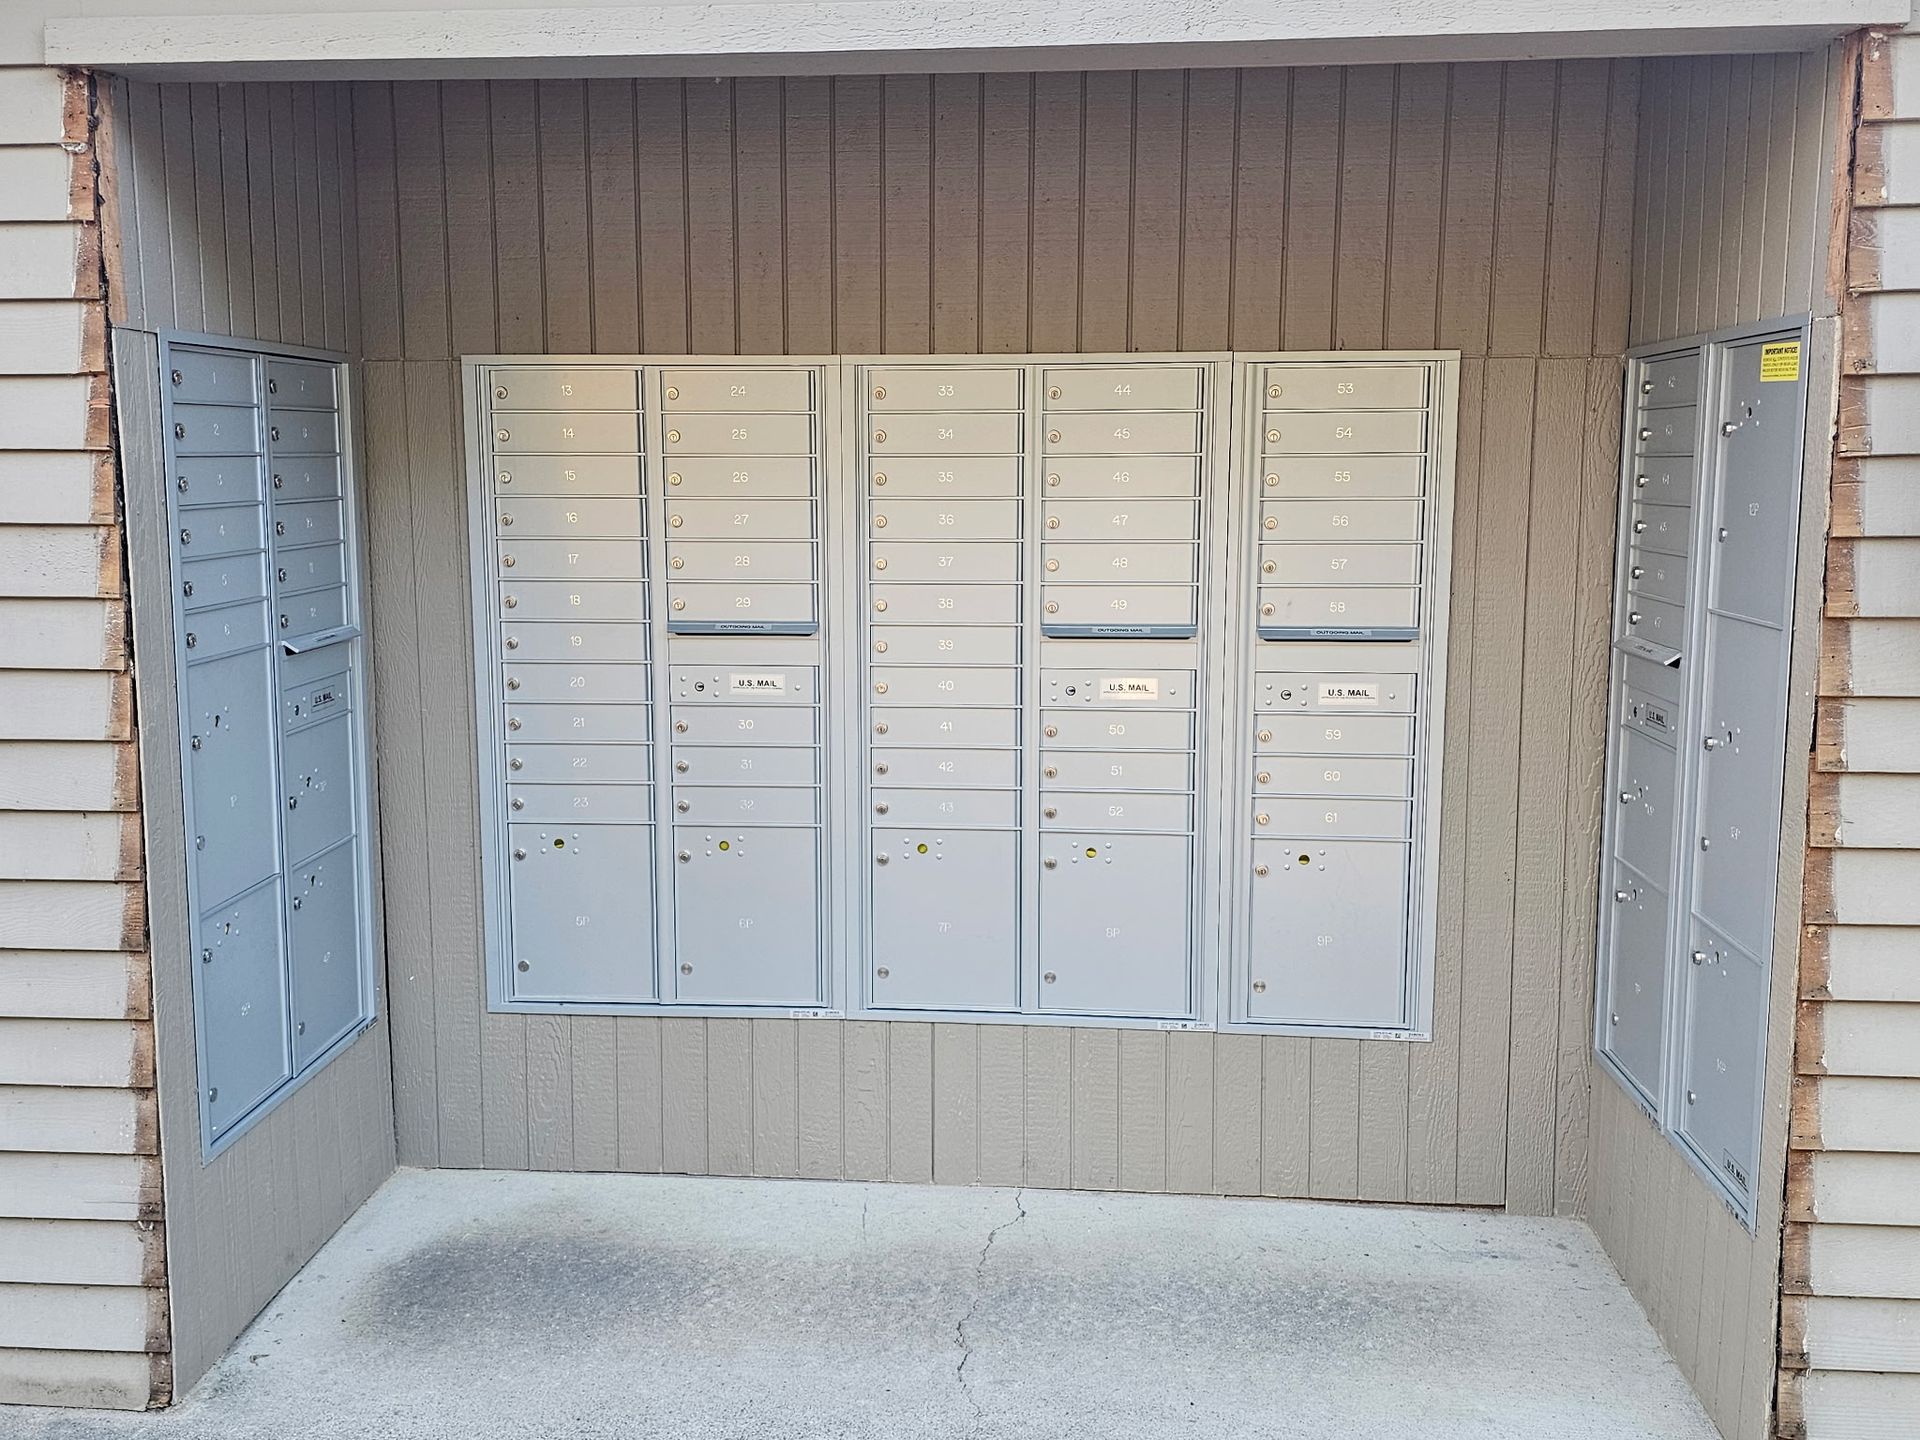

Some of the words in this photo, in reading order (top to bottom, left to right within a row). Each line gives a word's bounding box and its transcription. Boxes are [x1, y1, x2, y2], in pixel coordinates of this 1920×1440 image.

[561, 384, 573, 397] 13
[730, 385, 747, 397] 24
[937, 385, 954, 397] 33
[1113, 384, 1132, 396] 44
[1337, 383, 1354, 395] 53
[213, 424, 220, 436] 2
[562, 427, 575, 439] 14
[731, 428, 748, 440] 25
[937, 428, 954, 440] 34
[1113, 428, 1131, 440] 45
[1335, 427, 1353, 439] 54
[216, 474, 223, 486] 3
[304, 473, 310, 482] 9
[564, 470, 576, 481] 15
[732, 471, 749, 483] 26
[937, 471, 954, 483] 35
[1112, 471, 1130, 483] 46
[1334, 471, 1351, 482] 55
[565, 511, 578, 524] 16
[733, 513, 750, 525] 27
[938, 514, 955, 526] 36
[1111, 514, 1129, 526] 47
[1332, 515, 1349, 527] 56
[219, 525, 225, 536] 4
[567, 553, 580, 565] 17
[734, 555, 750, 567] 28
[937, 556, 954, 567] 37
[1111, 557, 1129, 569] 48
[1330, 558, 1348, 570] 57
[221, 574, 228, 586] 5
[569, 594, 581, 606] 18
[735, 596, 751, 608] 29
[937, 597, 954, 609] 38
[1110, 599, 1128, 610] 49
[1329, 601, 1346, 613] 58
[224, 624, 230, 636] 6
[570, 635, 582, 647] 19
[938, 639, 954, 651] 39
[569, 676, 586, 688] 20
[738, 679, 755, 687] U.S.
[756, 679, 777, 687] MAIL
[937, 680, 955, 691] 40
[1109, 683, 1126, 691] U.S.
[1327, 688, 1345, 696] U.S.
[1347, 689, 1370, 697] MAIL
[573, 717, 585, 728] 21
[737, 719, 754, 730] 30
[939, 721, 953, 732] 41
[1108, 724, 1126, 736] 50
[1324, 729, 1342, 741] 59
[572, 757, 587, 768] 22
[740, 759, 753, 770] 31
[938, 761, 954, 773] 42
[1110, 765, 1123, 777] 51
[1323, 770, 1341, 782] 60
[573, 796, 589, 808] 23
[739, 799, 754, 810] 32
[938, 801, 954, 813] 43
[1108, 805, 1124, 817] 52
[1325, 811, 1338, 824] 61
[575, 915, 590, 927] 5P
[738, 918, 754, 929] 6P
[937, 921, 952, 933] 7P
[1317, 935, 1333, 947] 9P
